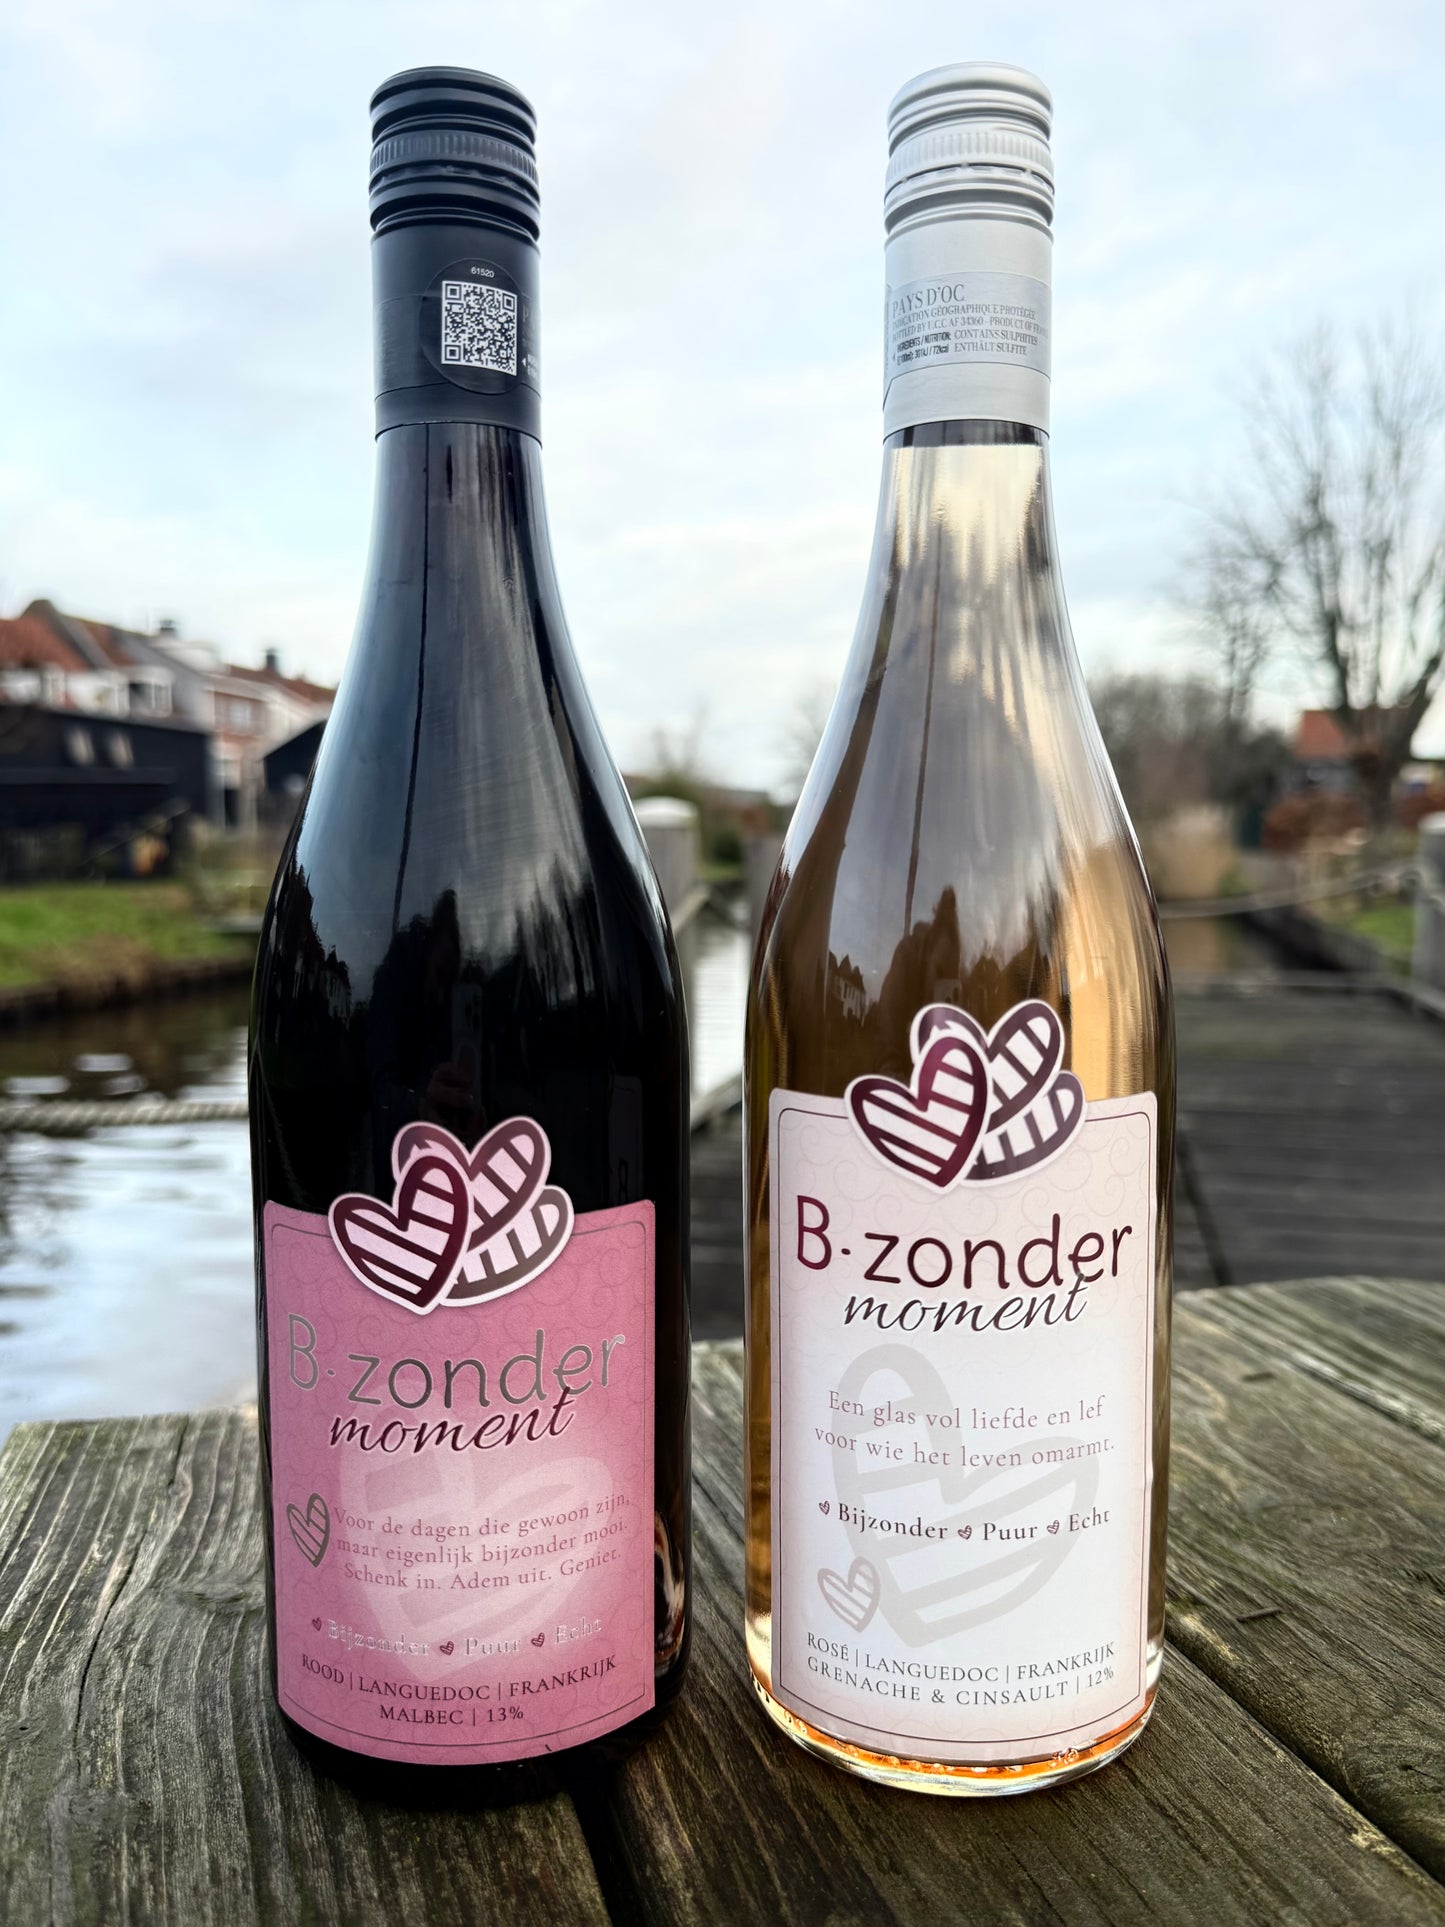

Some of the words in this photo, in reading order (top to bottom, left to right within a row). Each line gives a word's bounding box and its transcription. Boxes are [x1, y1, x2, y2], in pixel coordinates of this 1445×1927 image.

[471, 266, 495, 278] 61520
[892, 291, 923, 319] PAYS
[917, 322, 927, 333] BY
[990, 316, 1023, 329] PRODUCT
[1033, 323, 1049, 340] FRA
[954, 328, 1000, 340] CONTAINS
[1000, 330, 1039, 346] SULPHITES
[844, 1273, 1088, 1332] moment
[330, 1386, 574, 1453] moment
[829, 1390, 865, 1417] Een
[873, 1401, 916, 1427] glas
[926, 1407, 961, 1429] vol
[972, 1406, 1038, 1430] liefde
[1047, 1409, 1071, 1426] en
[1079, 1395, 1106, 1420] lef
[815, 1427, 857, 1451] voor
[866, 1437, 904, 1461] wie
[914, 1442, 950, 1466] het
[961, 1446, 1022, 1467] leven
[1032, 1437, 1115, 1465] omarmt.
[334, 1507, 375, 1532] Voor
[382, 1516, 403, 1535] de
[411, 1519, 471, 1542] dagen
[479, 1518, 510, 1536] die
[519, 1507, 590, 1538] gewoon
[596, 1493, 630, 1514] zijn,
[838, 1502, 948, 1539] Bijzonder
[982, 1522, 1038, 1541] Puur
[1068, 1507, 1111, 1533] Echt
[336, 1538, 379, 1558] maar
[386, 1545, 473, 1570] eigenlijk
[482, 1535, 577, 1566] bijzonder
[584, 1517, 628, 1545] mooi.
[344, 1563, 408, 1588] Schenk
[417, 1574, 441, 1590] in.
[451, 1572, 510, 1590] Adem
[518, 1568, 552, 1585] uit.
[560, 1549, 622, 1576] Geniet.
[327, 1619, 429, 1656] Bijzonder
[464, 1637, 521, 1655] Puur
[555, 1616, 602, 1645] Echt
[302, 1653, 344, 1684] ROOD
[359, 1677, 490, 1700] LANGUEDOC
[509, 1654, 617, 1697] FRANKRIJK
[807, 1632, 849, 1661] ROSÉ
[866, 1653, 998, 1682] LANGUEDOC
[1017, 1642, 1116, 1680] FRANKRIJK
[807, 1656, 921, 1701] GRENACHE
[931, 1689, 946, 1703] &
[956, 1681, 1069, 1705] CINSAULT
[1087, 1666, 1115, 1688] 12%
[379, 1705, 464, 1725] MALBEC
[487, 1707, 524, 1722] 13%
